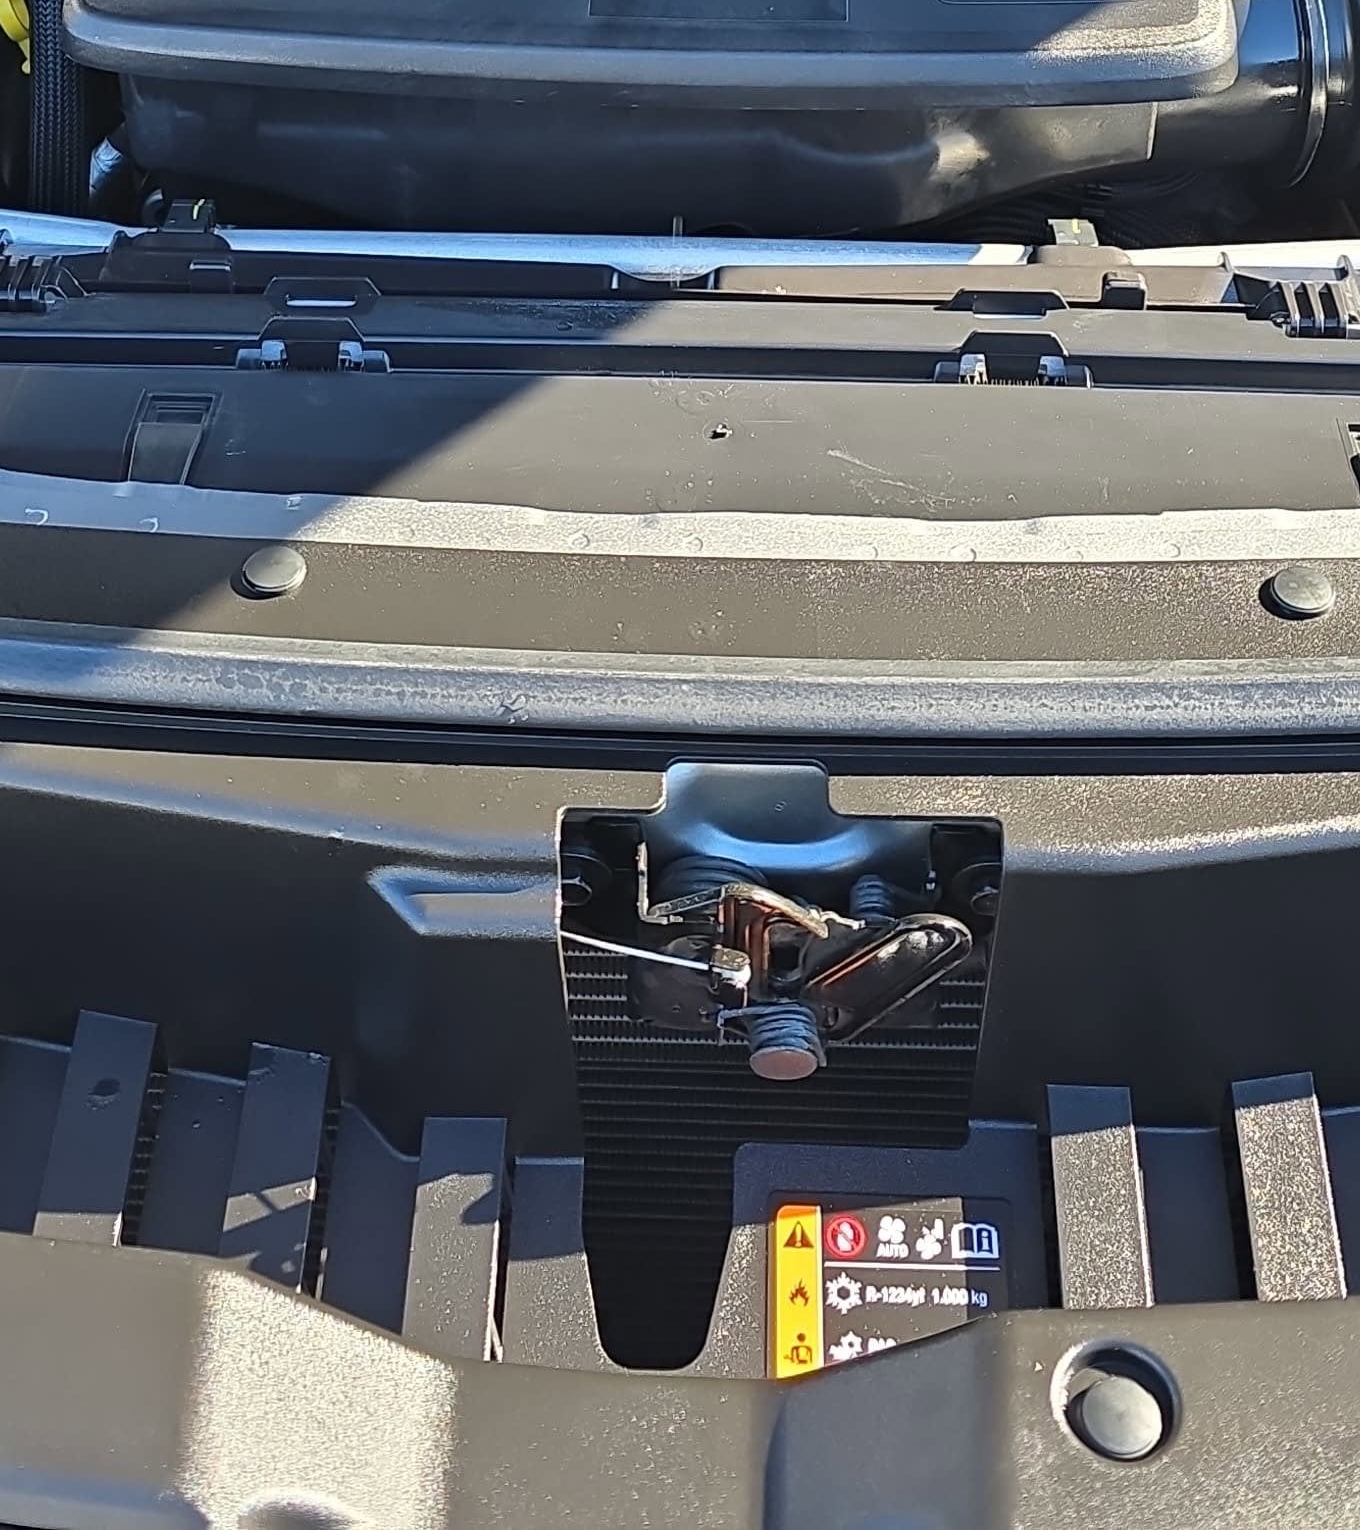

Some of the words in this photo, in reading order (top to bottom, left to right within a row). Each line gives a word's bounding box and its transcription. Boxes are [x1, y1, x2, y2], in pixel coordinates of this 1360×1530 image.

[876, 1242, 910, 1259] AUTO
[865, 1285, 927, 1307] R-1234yf
[931, 1286, 969, 1306] 1.000
[971, 1289, 988, 1307] kg
